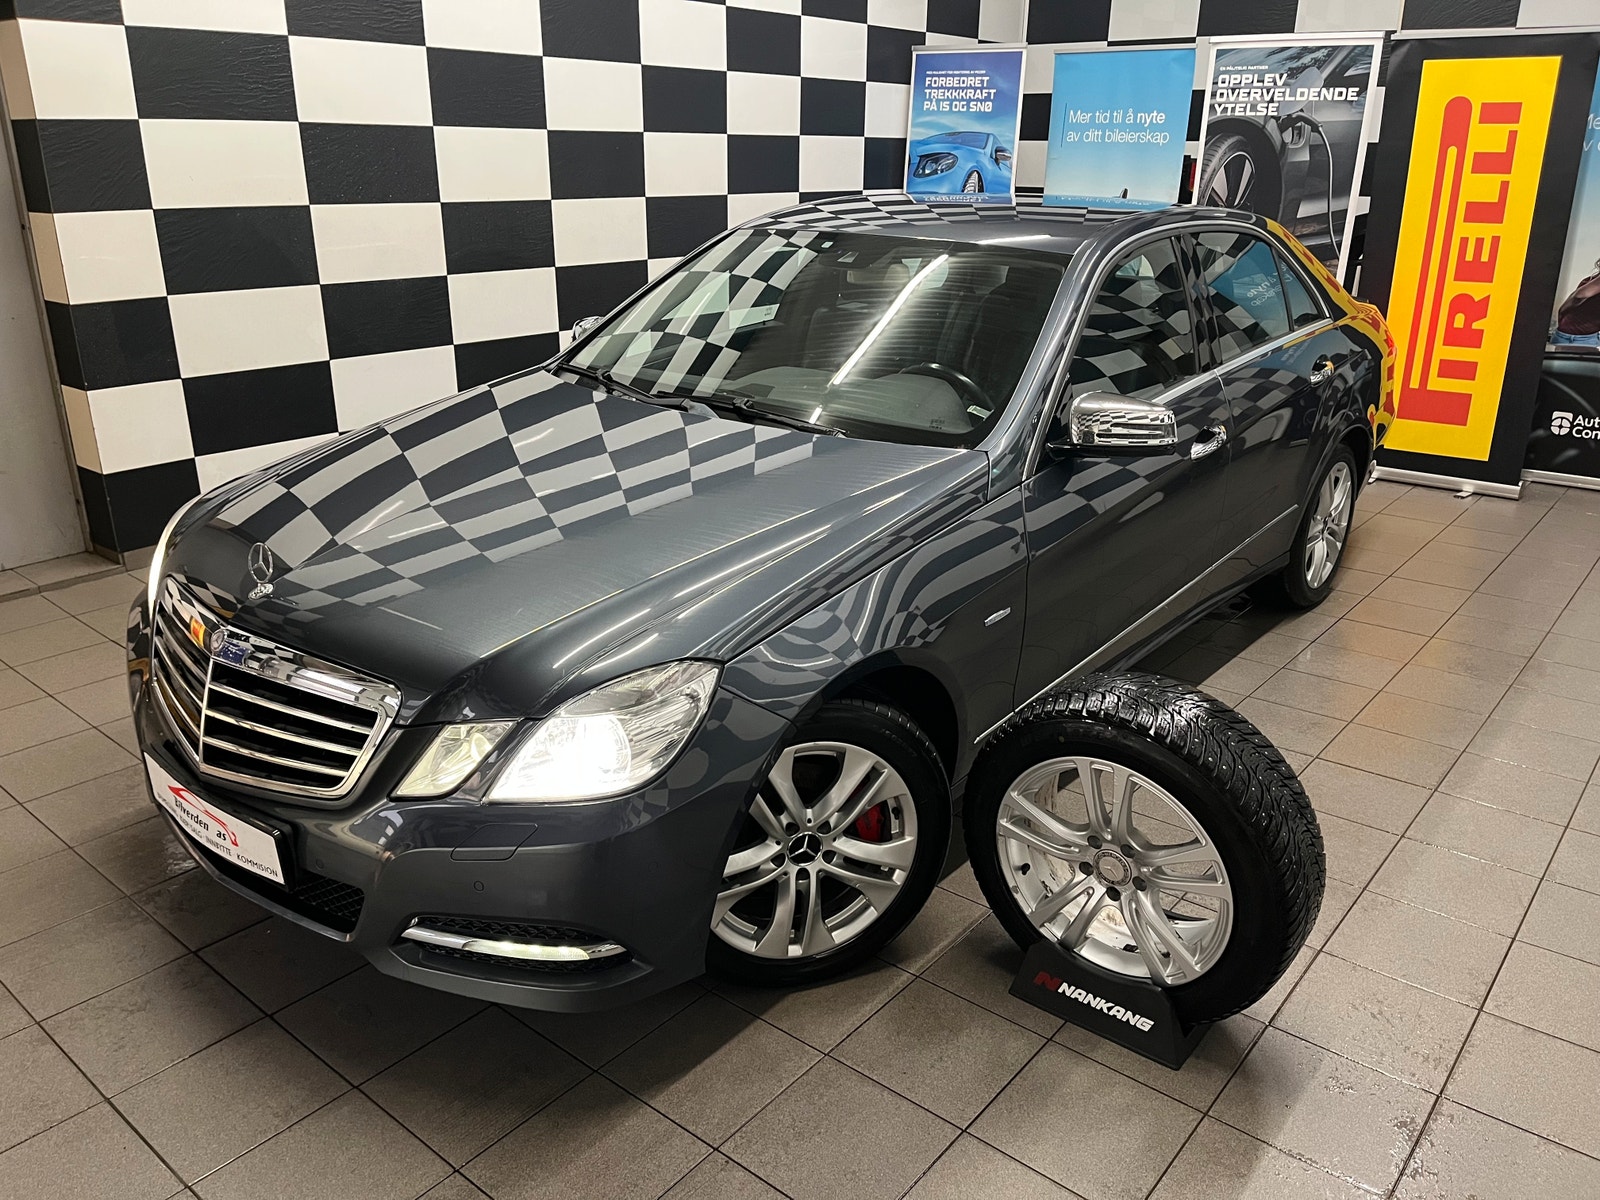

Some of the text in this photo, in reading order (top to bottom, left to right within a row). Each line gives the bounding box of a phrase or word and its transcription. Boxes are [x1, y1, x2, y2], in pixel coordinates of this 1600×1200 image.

[925, 76, 990, 87] FORBEDRET
[1217, 73, 1288, 88] OPPLEV
[924, 89, 997, 100] TREKKKRAFT
[1216, 87, 1360, 102] OVERVELDENDE
[923, 98, 993, 112] PÅ IS OG SNØ
[1214, 102, 1280, 117] YTELSE
[1069, 107, 1166, 127] Mer tid til å nyte
[1066, 128, 1170, 147] av ditt bileierskap
[1396, 96, 1523, 426] PIRELLI
[215, 829, 227, 841] as
[1057, 982, 1155, 1033] NANKANG
